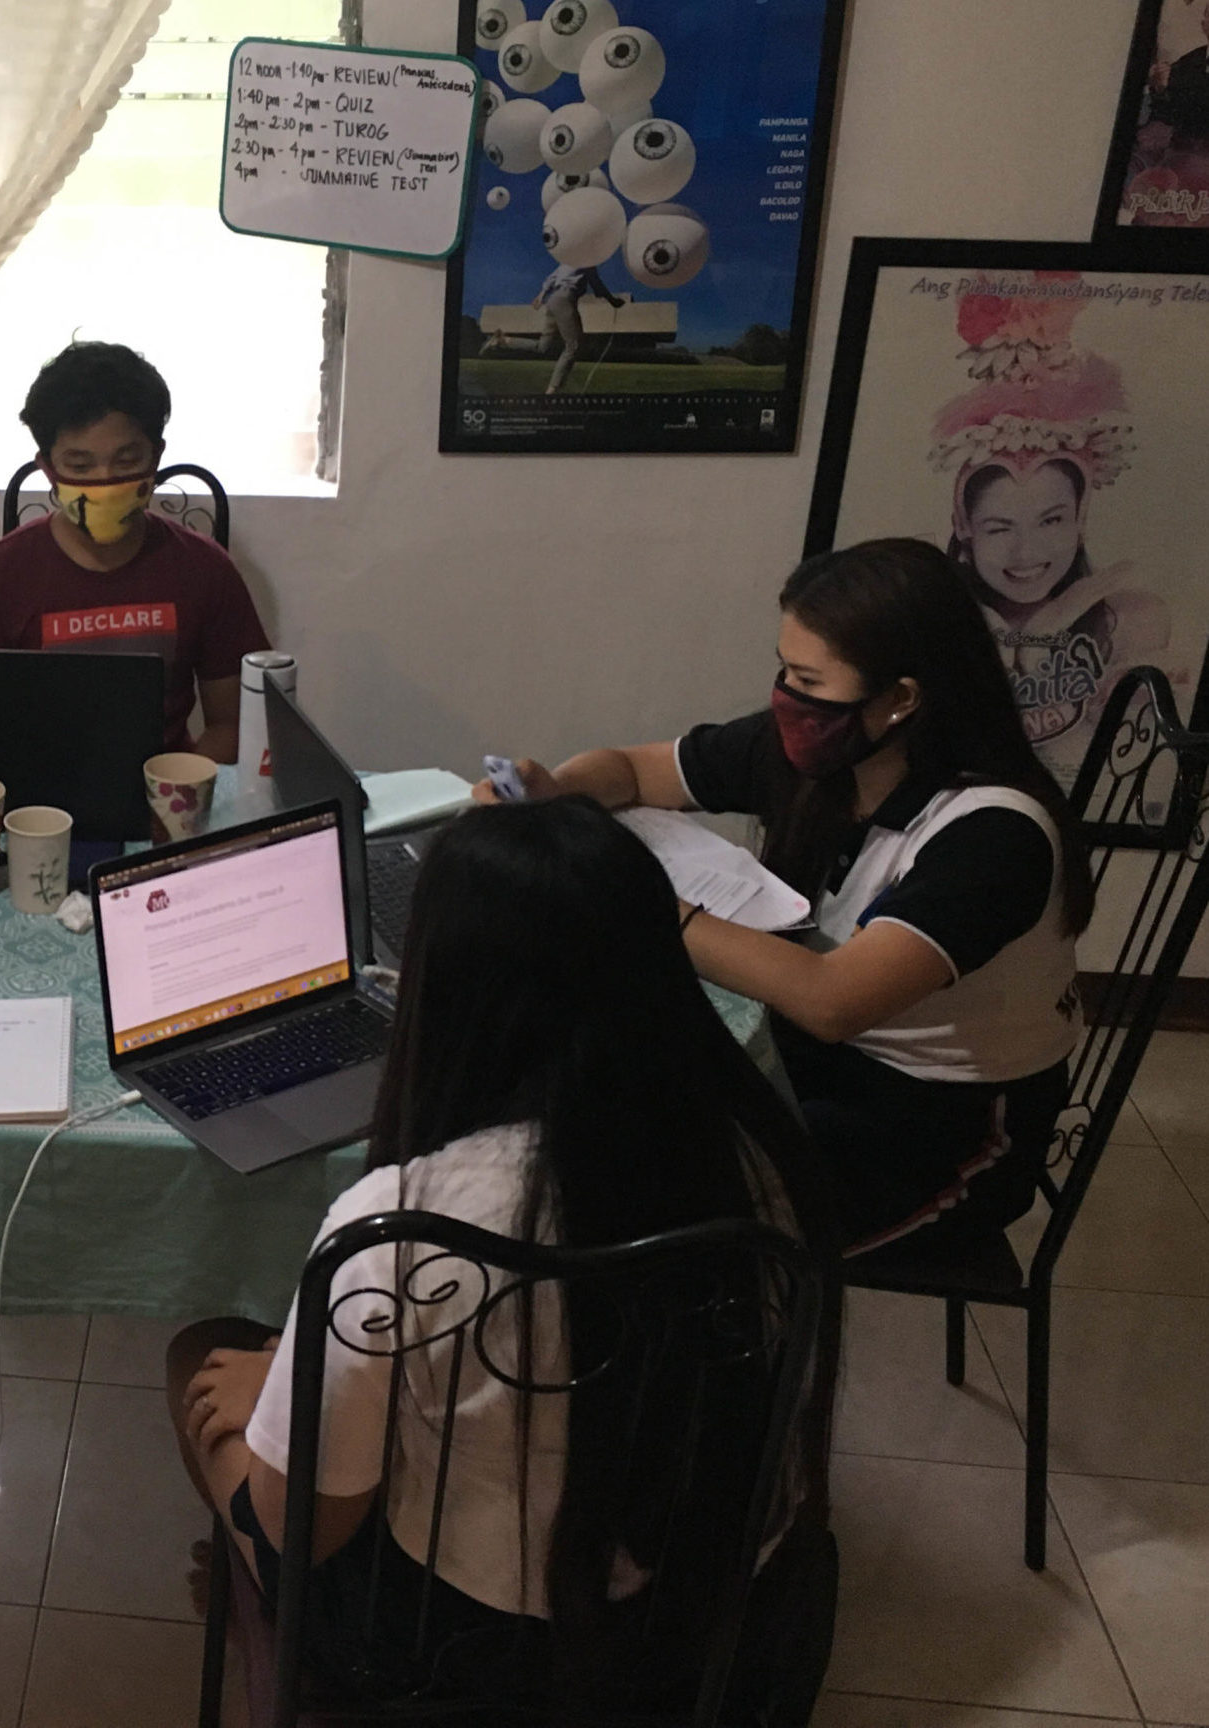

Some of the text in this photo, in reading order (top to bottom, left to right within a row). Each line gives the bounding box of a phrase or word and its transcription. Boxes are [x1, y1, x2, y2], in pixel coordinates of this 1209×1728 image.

[239, 57, 252, 76] 12
[256, 63, 282, 79] noon
[334, 65, 391, 86] REVIEW
[335, 92, 375, 114] QUIZ
[333, 119, 390, 141] TUROG
[758, 117, 809, 128] PAMPANGA
[772, 133, 807, 142] MANILA
[300, 168, 379, 190] SUMMATIVE
[391, 175, 429, 191] TEST
[766, 165, 804, 174] LEGAZPI
[774, 181, 803, 190] ILOILO
[759, 197, 801, 206] BACOLOD
[769, 212, 799, 221] DAVAO
[910, 277, 951, 299] Ang
[53, 610, 164, 635] I DECLARE
[1008, 650, 1097, 705] nita
